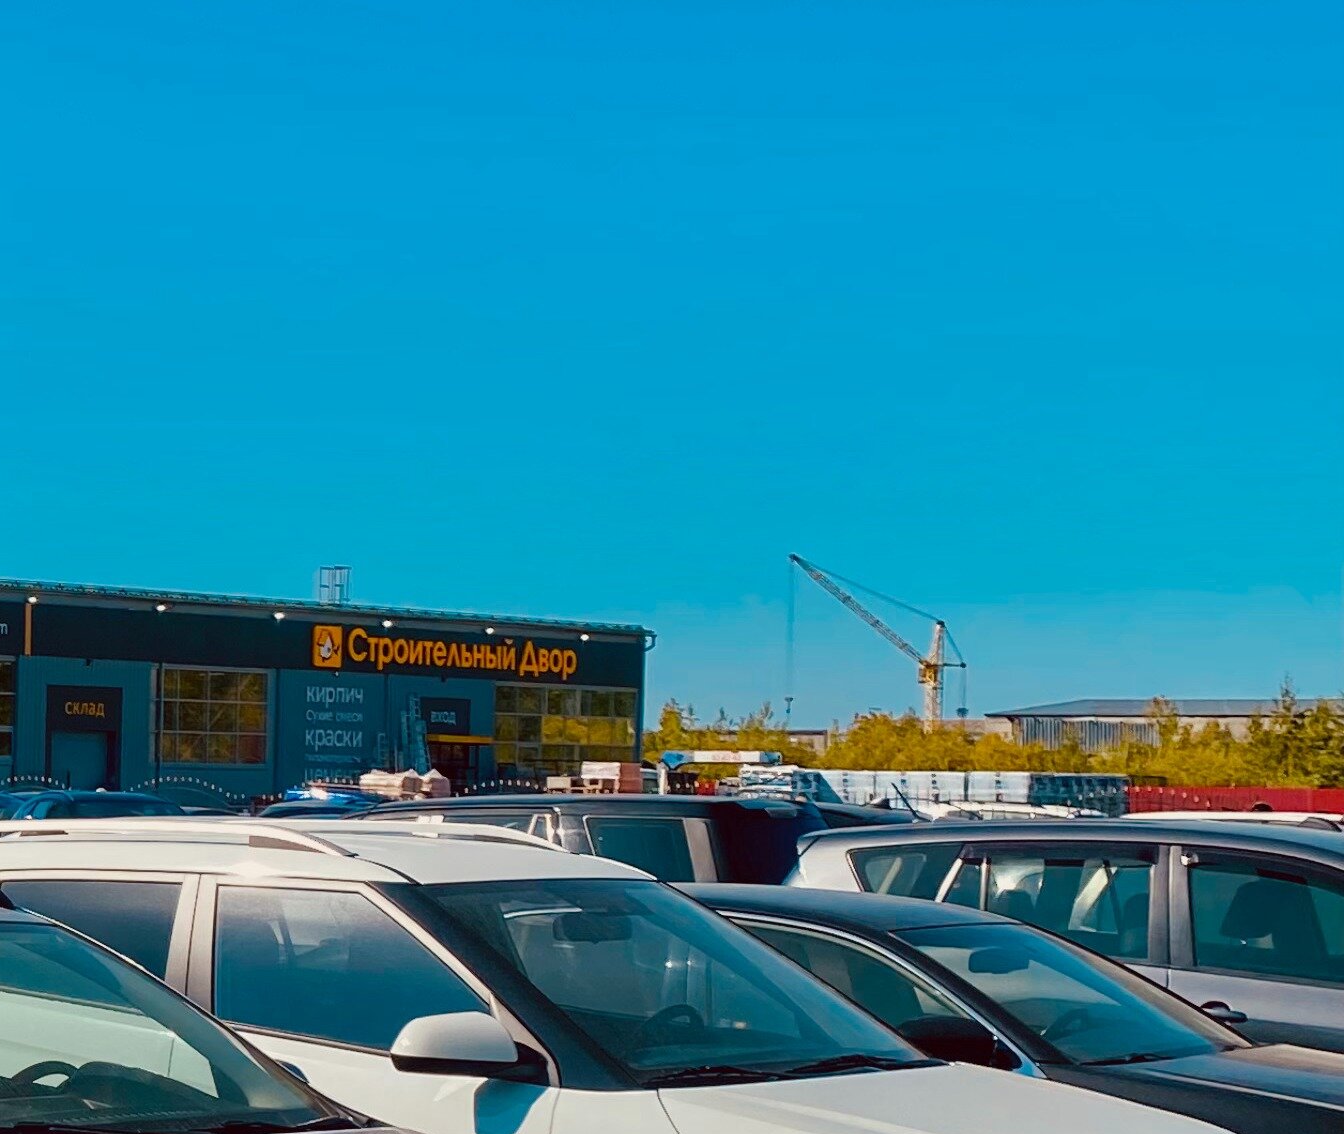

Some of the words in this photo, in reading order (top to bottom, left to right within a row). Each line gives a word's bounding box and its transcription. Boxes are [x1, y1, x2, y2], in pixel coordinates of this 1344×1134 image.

[348, 628, 516, 671] Строительный
[519, 641, 578, 680] Двор
[306, 686, 364, 708] кирпич
[305, 729, 363, 752] краски
